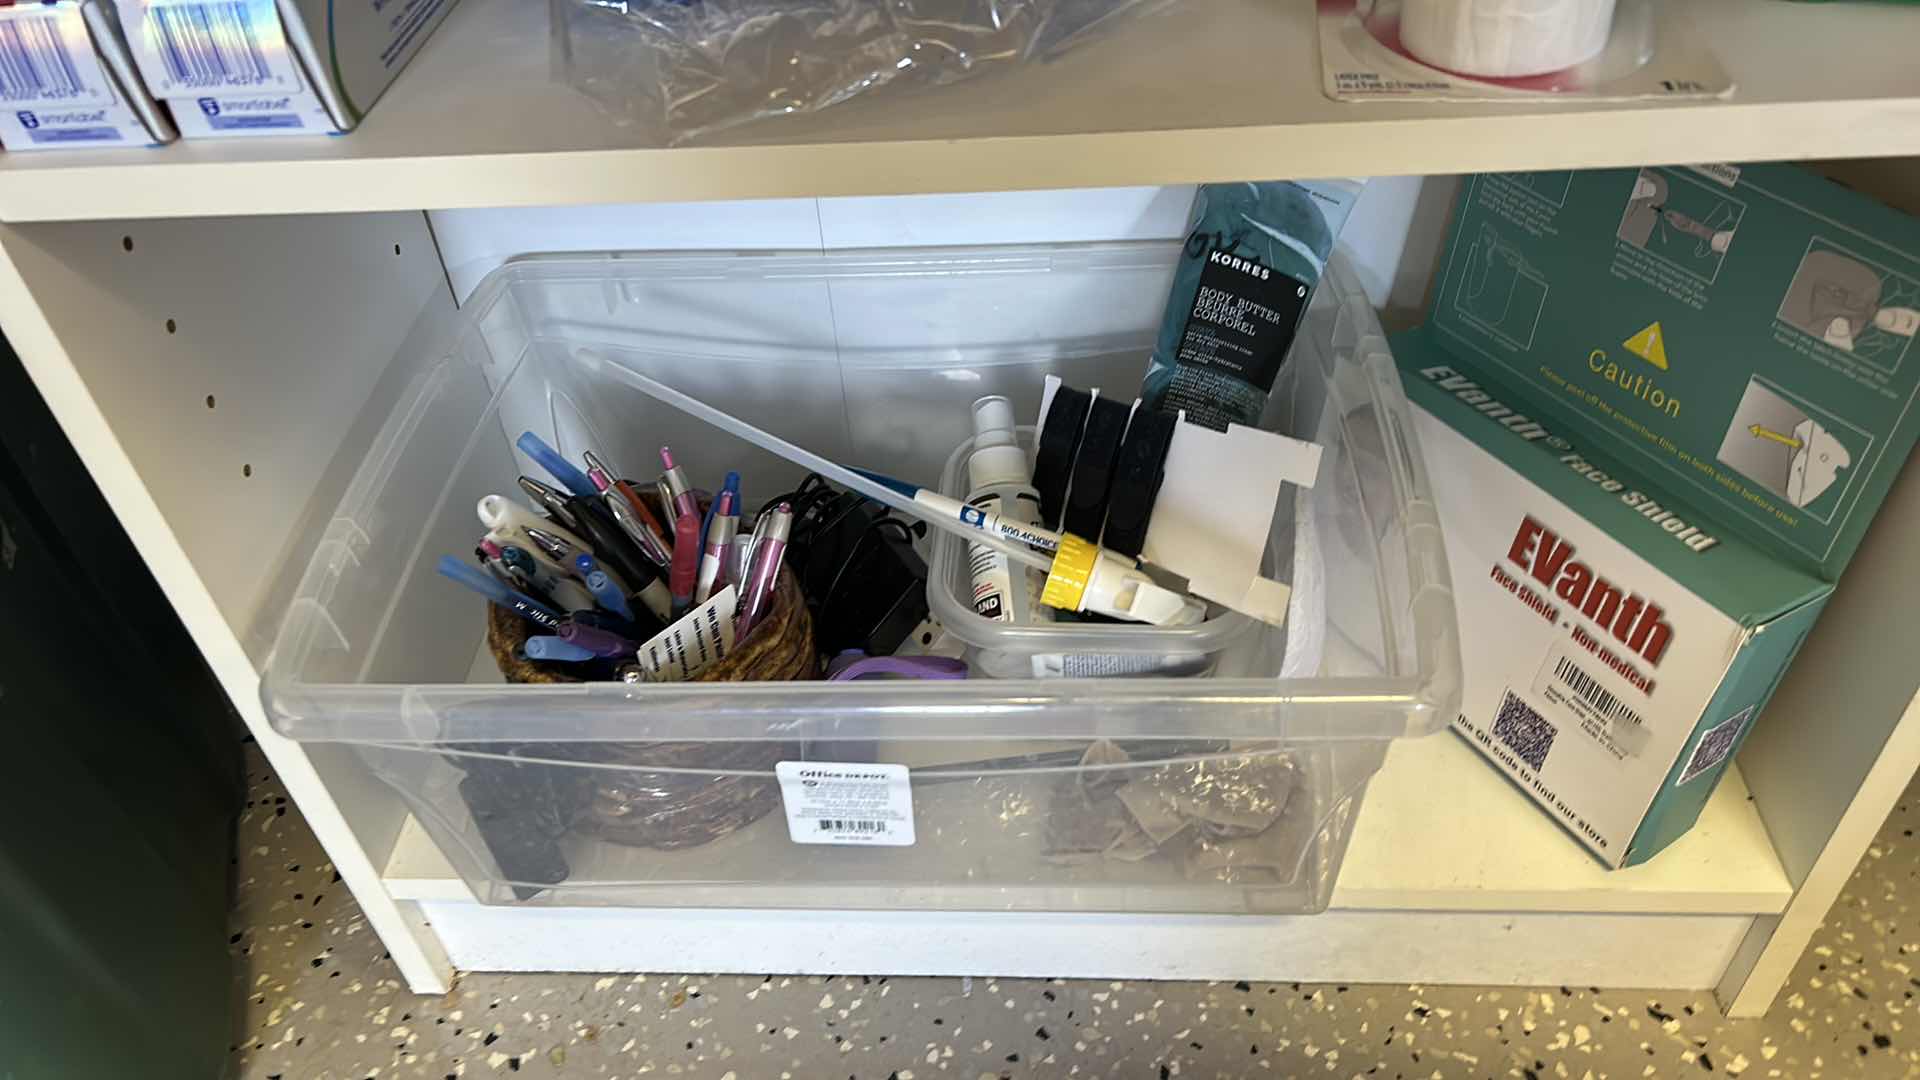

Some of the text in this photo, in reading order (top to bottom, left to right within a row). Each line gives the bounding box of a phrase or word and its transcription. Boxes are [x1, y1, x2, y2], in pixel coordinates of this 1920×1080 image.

[1210, 251, 1271, 282] KORRES
[1192, 307, 1257, 336] CORPOREL
[1196, 298, 1245, 322] BEURRE
[1200, 286, 1282, 326] BODY BUTTER
[1587, 349, 1682, 418] Caution
[1560, 453, 1623, 493] Face
[1621, 488, 1720, 553] Shield
[1488, 563, 1519, 593] Face
[1518, 581, 1558, 625] Shield
[1507, 516, 1674, 668] EVanth
[799, 769, 843, 779] Office
[1492, 746, 1521, 770] code
[1519, 768, 1533, 783] to
[1532, 779, 1557, 802] find
[1557, 802, 1577, 820] our
[1577, 821, 1609, 848] store
